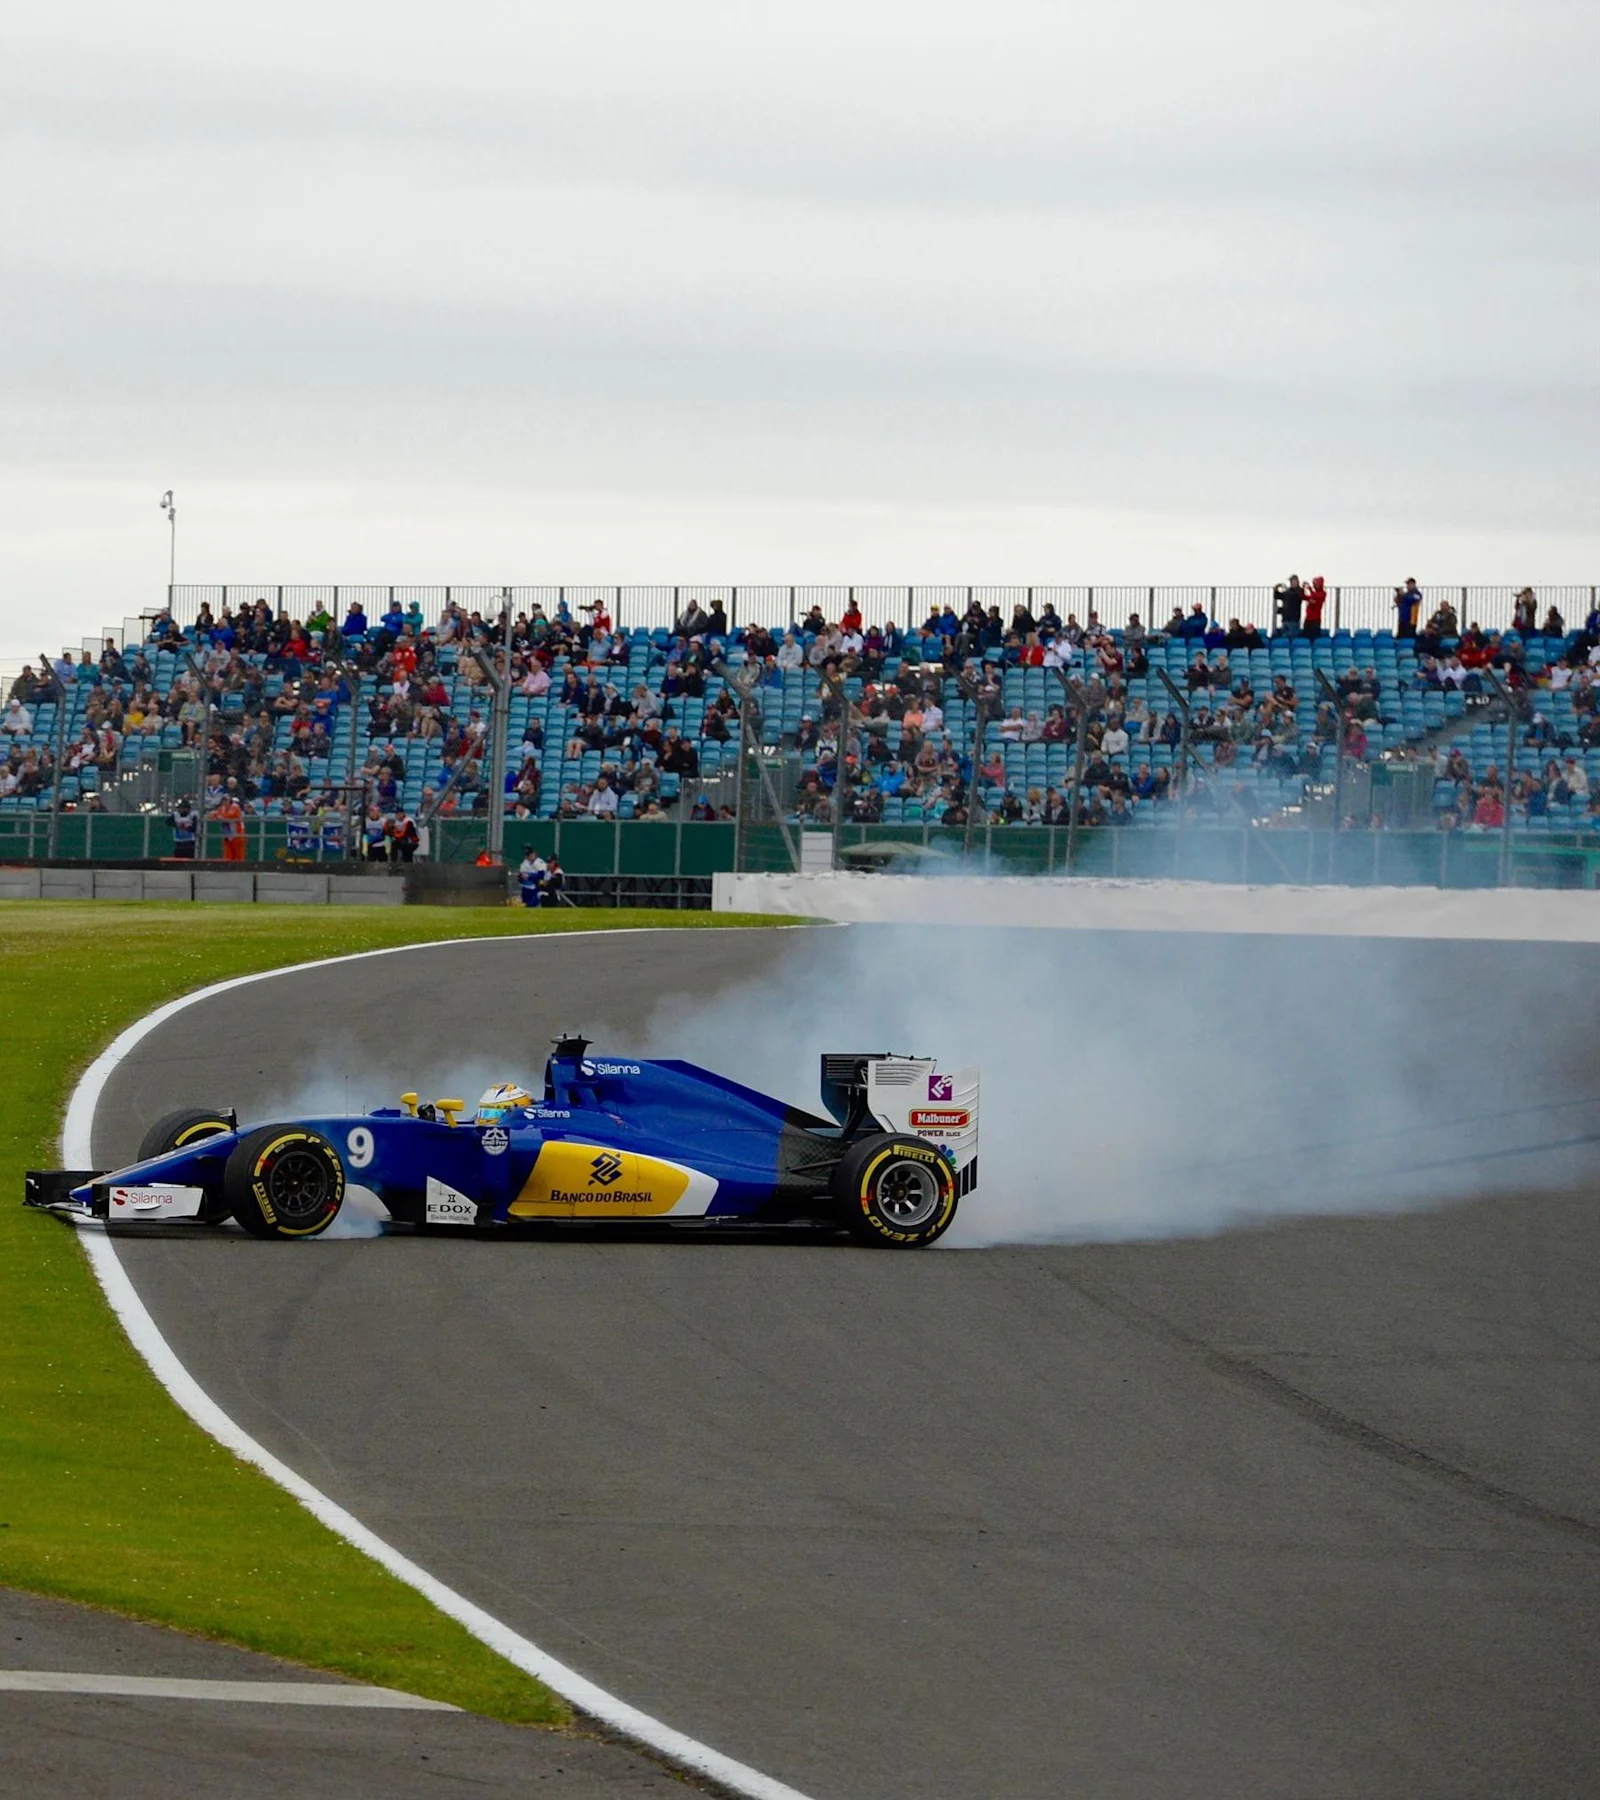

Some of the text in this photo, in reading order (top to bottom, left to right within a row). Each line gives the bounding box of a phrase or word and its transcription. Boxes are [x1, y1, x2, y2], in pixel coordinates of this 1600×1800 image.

[597, 1063, 641, 1075] Silanna
[537, 1108, 571, 1119] Silanna
[917, 1129, 945, 1137] POWER
[346, 1126, 375, 1169] 9
[893, 1144, 936, 1164] PIRELLI
[130, 1192, 173, 1204] Silanna
[550, 1189, 653, 1203] BANCO DO BRASIL
[427, 1204, 471, 1214] EDOX
